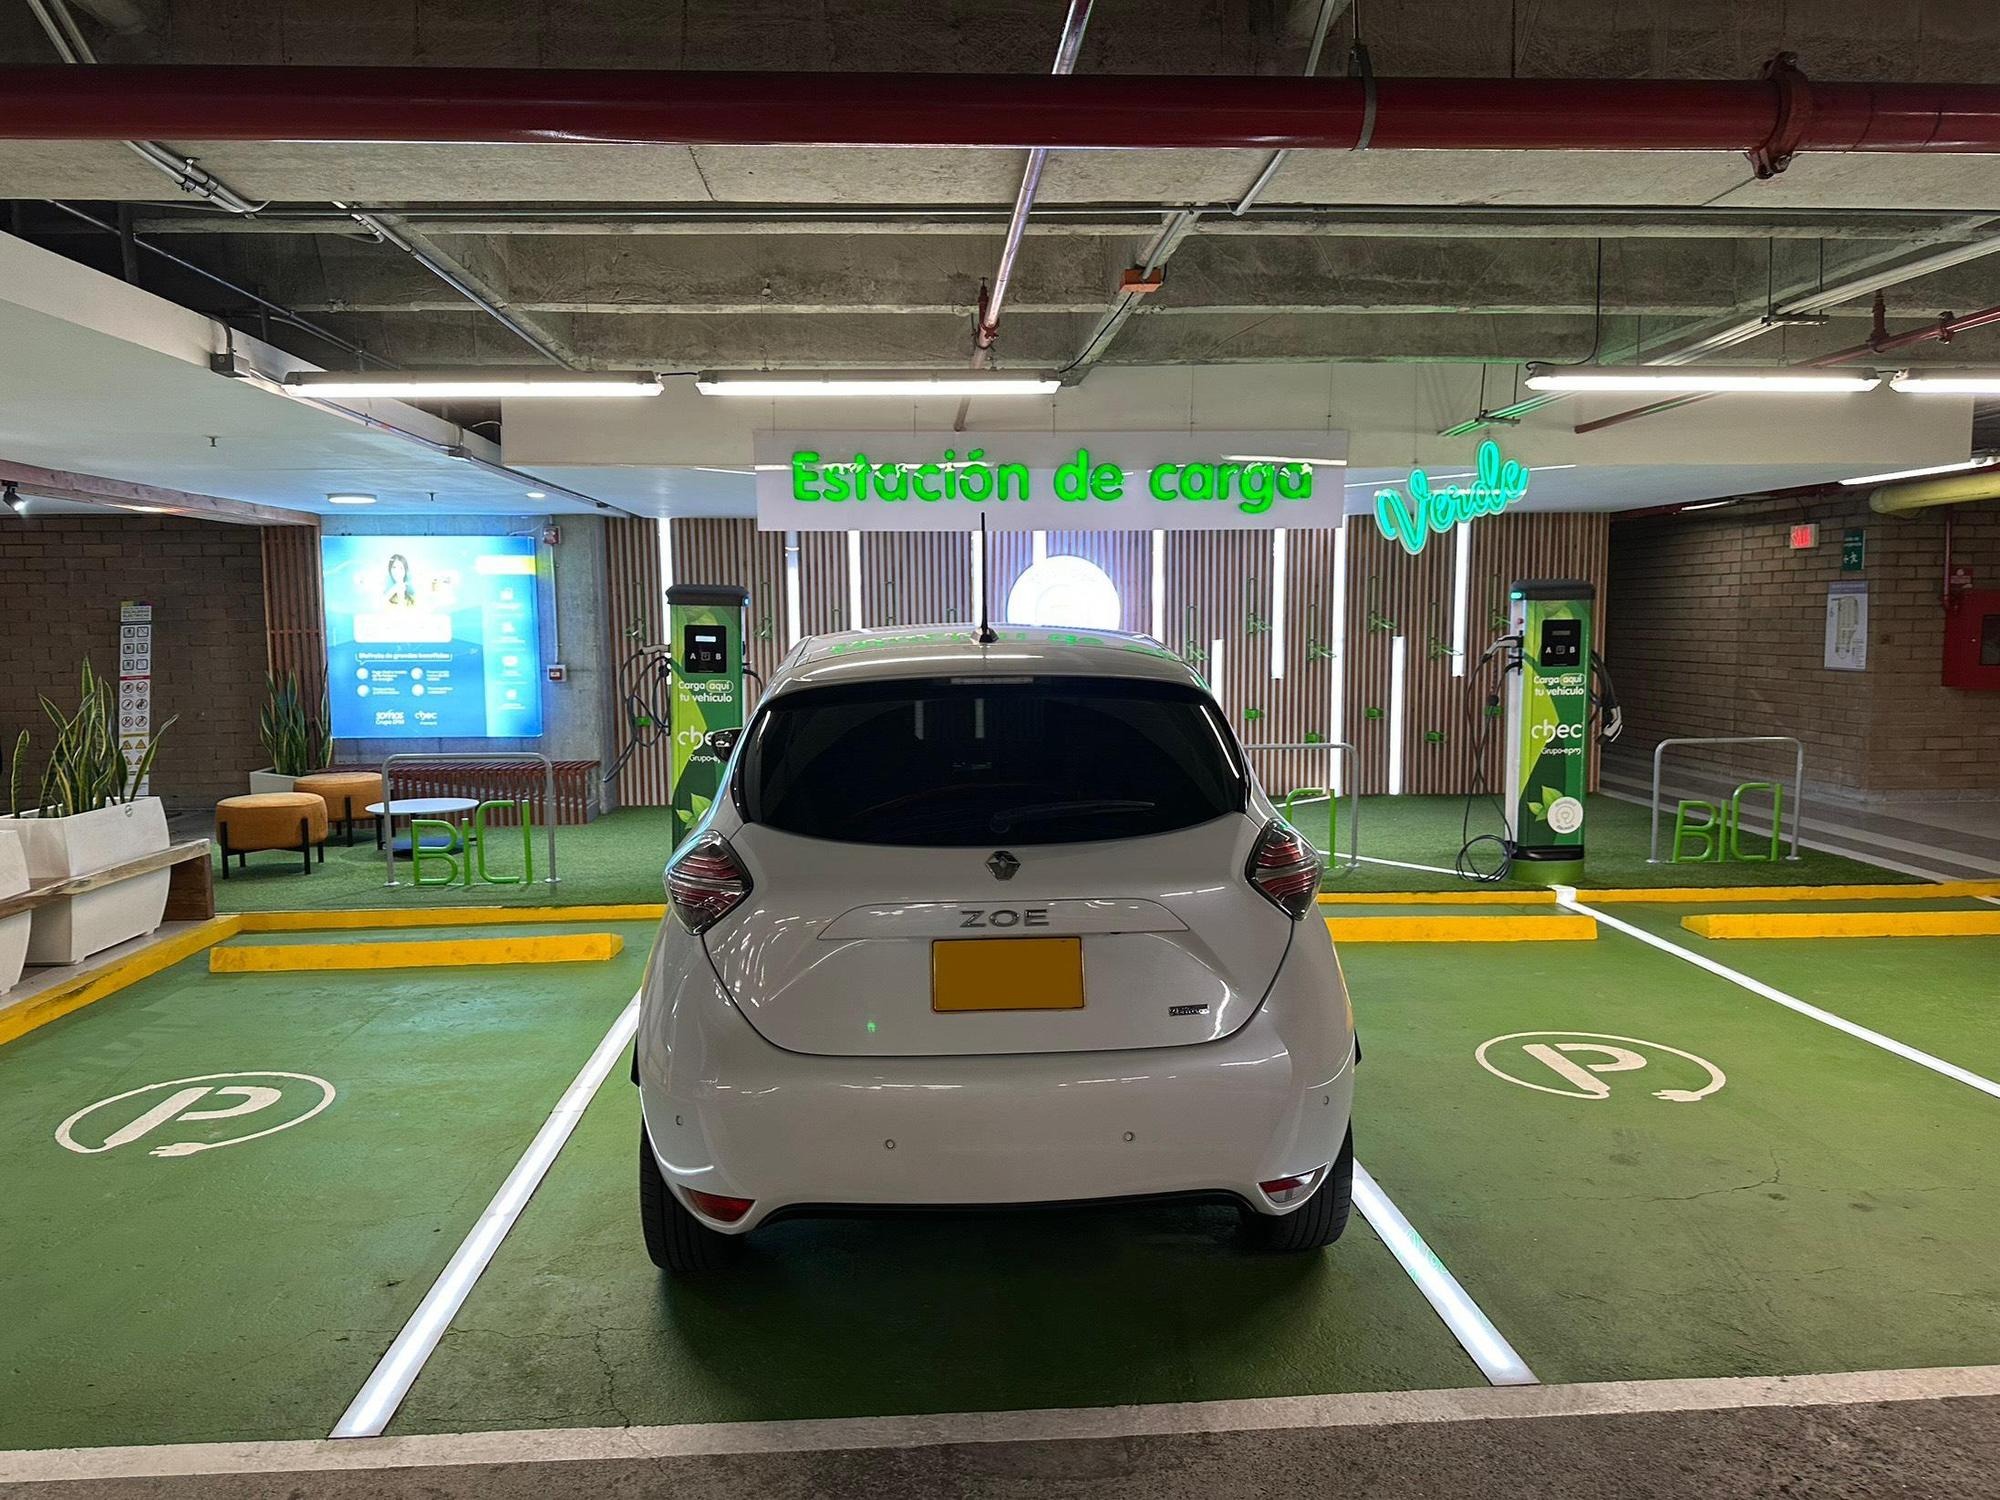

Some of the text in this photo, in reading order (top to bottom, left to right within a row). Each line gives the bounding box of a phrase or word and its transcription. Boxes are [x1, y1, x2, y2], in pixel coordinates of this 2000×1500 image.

[791, 448, 1313, 514] Estación de carga
[1375, 440, 1529, 554] Verde
[690, 652, 722, 660] A B
[1545, 646, 1576, 654] A B
[678, 681, 706, 691] Carga
[1534, 675, 1560, 686] Carga
[679, 692, 733, 702] tu vehículo
[1535, 686, 1585, 697] tu vehículo
[678, 725, 713, 750] che
[1531, 719, 1583, 743] chec
[1672, 782, 1783, 864] BICI
[411, 799, 533, 886] BICI
[959, 908, 1050, 929] ZOE
